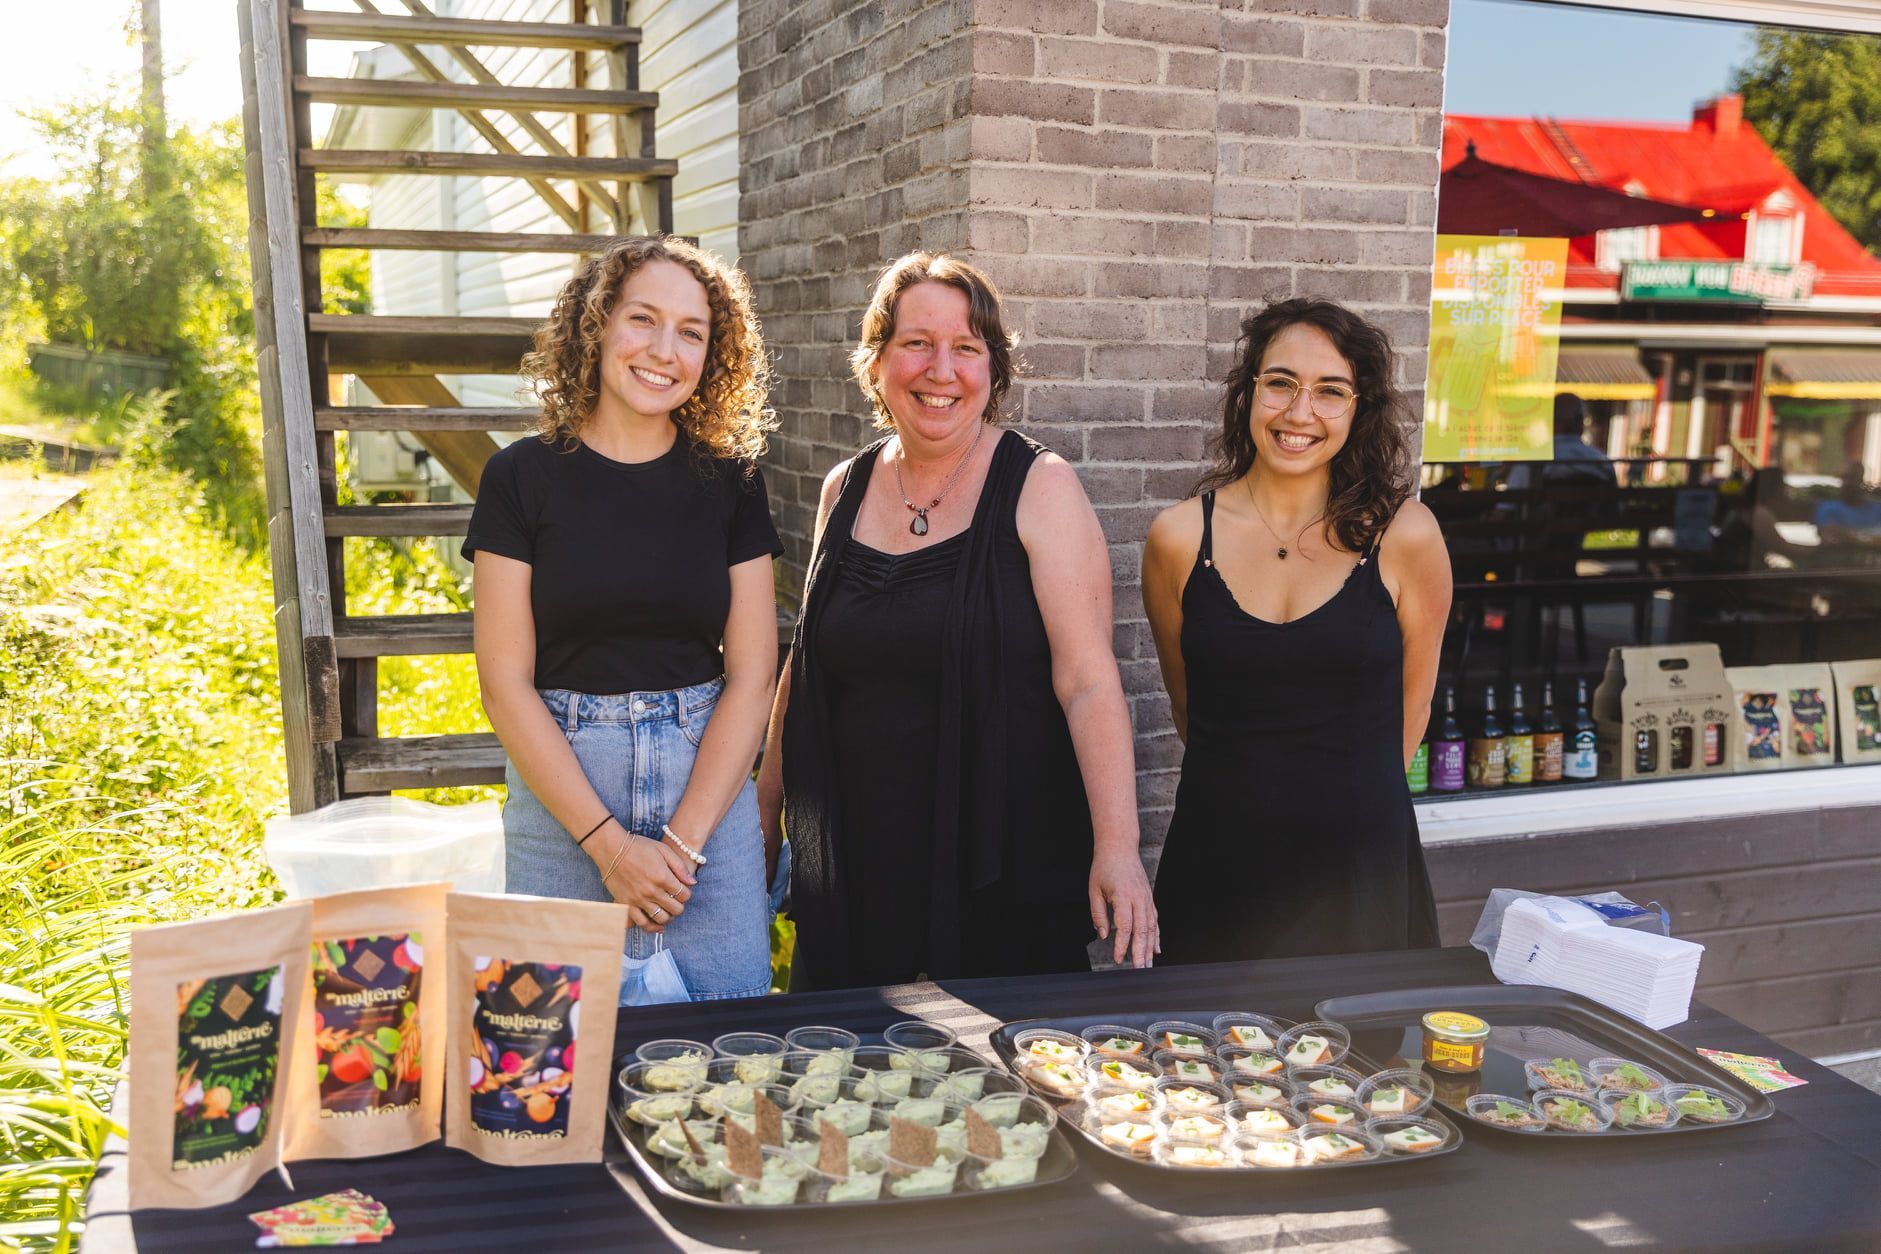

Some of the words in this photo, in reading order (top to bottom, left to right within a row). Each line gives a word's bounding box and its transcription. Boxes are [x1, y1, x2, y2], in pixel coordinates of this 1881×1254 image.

[1508, 259, 1555, 277] POUR
[1454, 275, 1544, 293] EMPORTER
[1451, 309, 1485, 325] SUR
